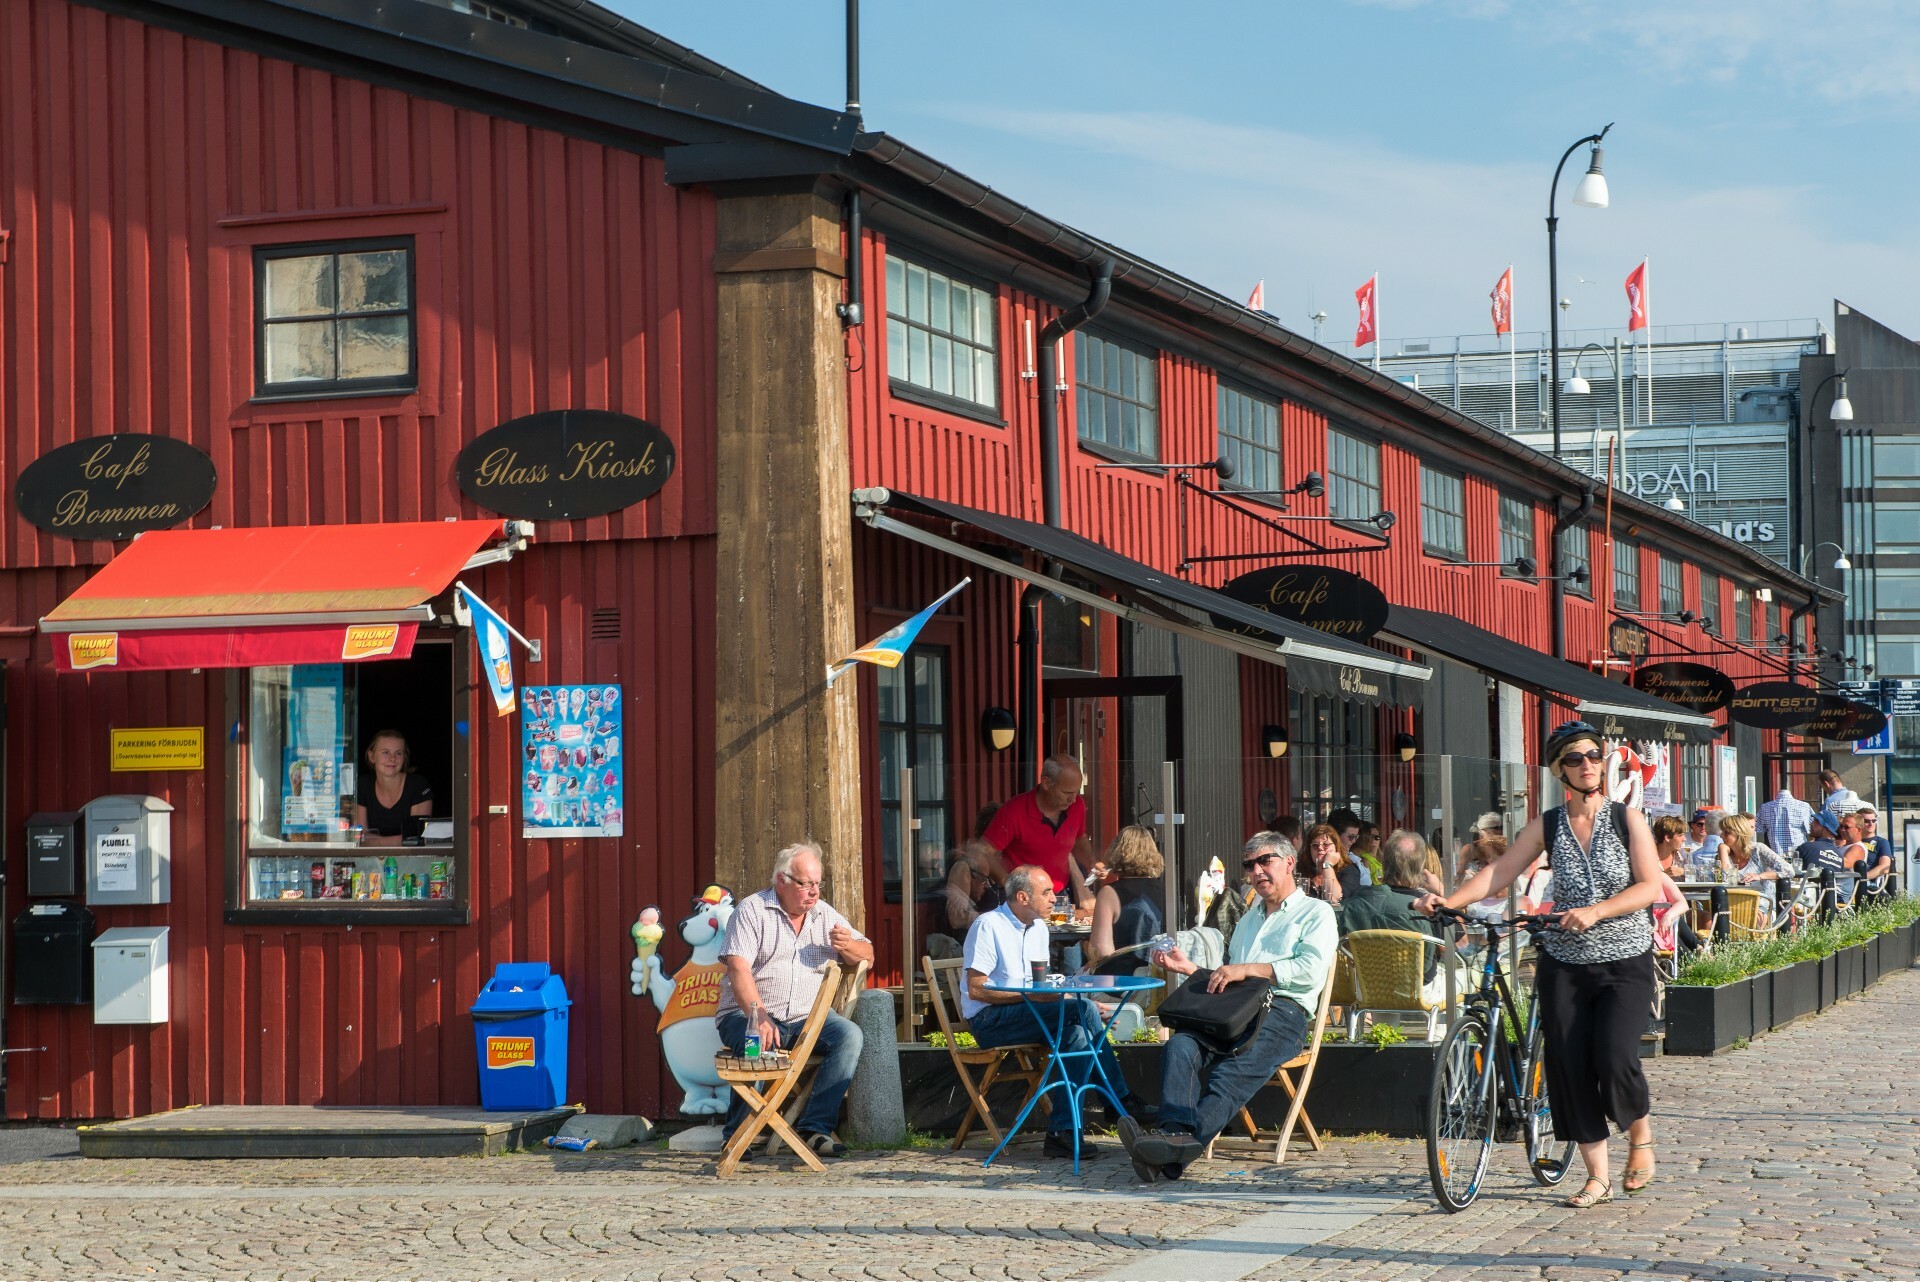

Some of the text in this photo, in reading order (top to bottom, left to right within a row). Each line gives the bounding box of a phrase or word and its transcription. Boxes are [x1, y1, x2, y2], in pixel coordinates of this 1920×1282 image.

[80, 443, 151, 489] Café
[475, 440, 656, 487] Glass Kiosk
[52, 489, 180, 527] Bommen
[1707, 520, 1775, 542] ld's
[1265, 573, 1329, 615] Café
[349, 629, 394, 640] TRIUMF
[72, 638, 114, 650] TRIUMF
[355, 640, 384, 648] GLASS
[80, 649, 107, 658] GLASS
[1645, 671, 1711, 687] Bommens
[1731, 699, 1779, 708] POINT
[118, 738, 197, 748] PARKERING FÖRBJUDEN
[678, 971, 724, 994] TRIUM
[680, 988, 718, 1008] GLAS
[490, 1042, 531, 1051] TRIUMF
